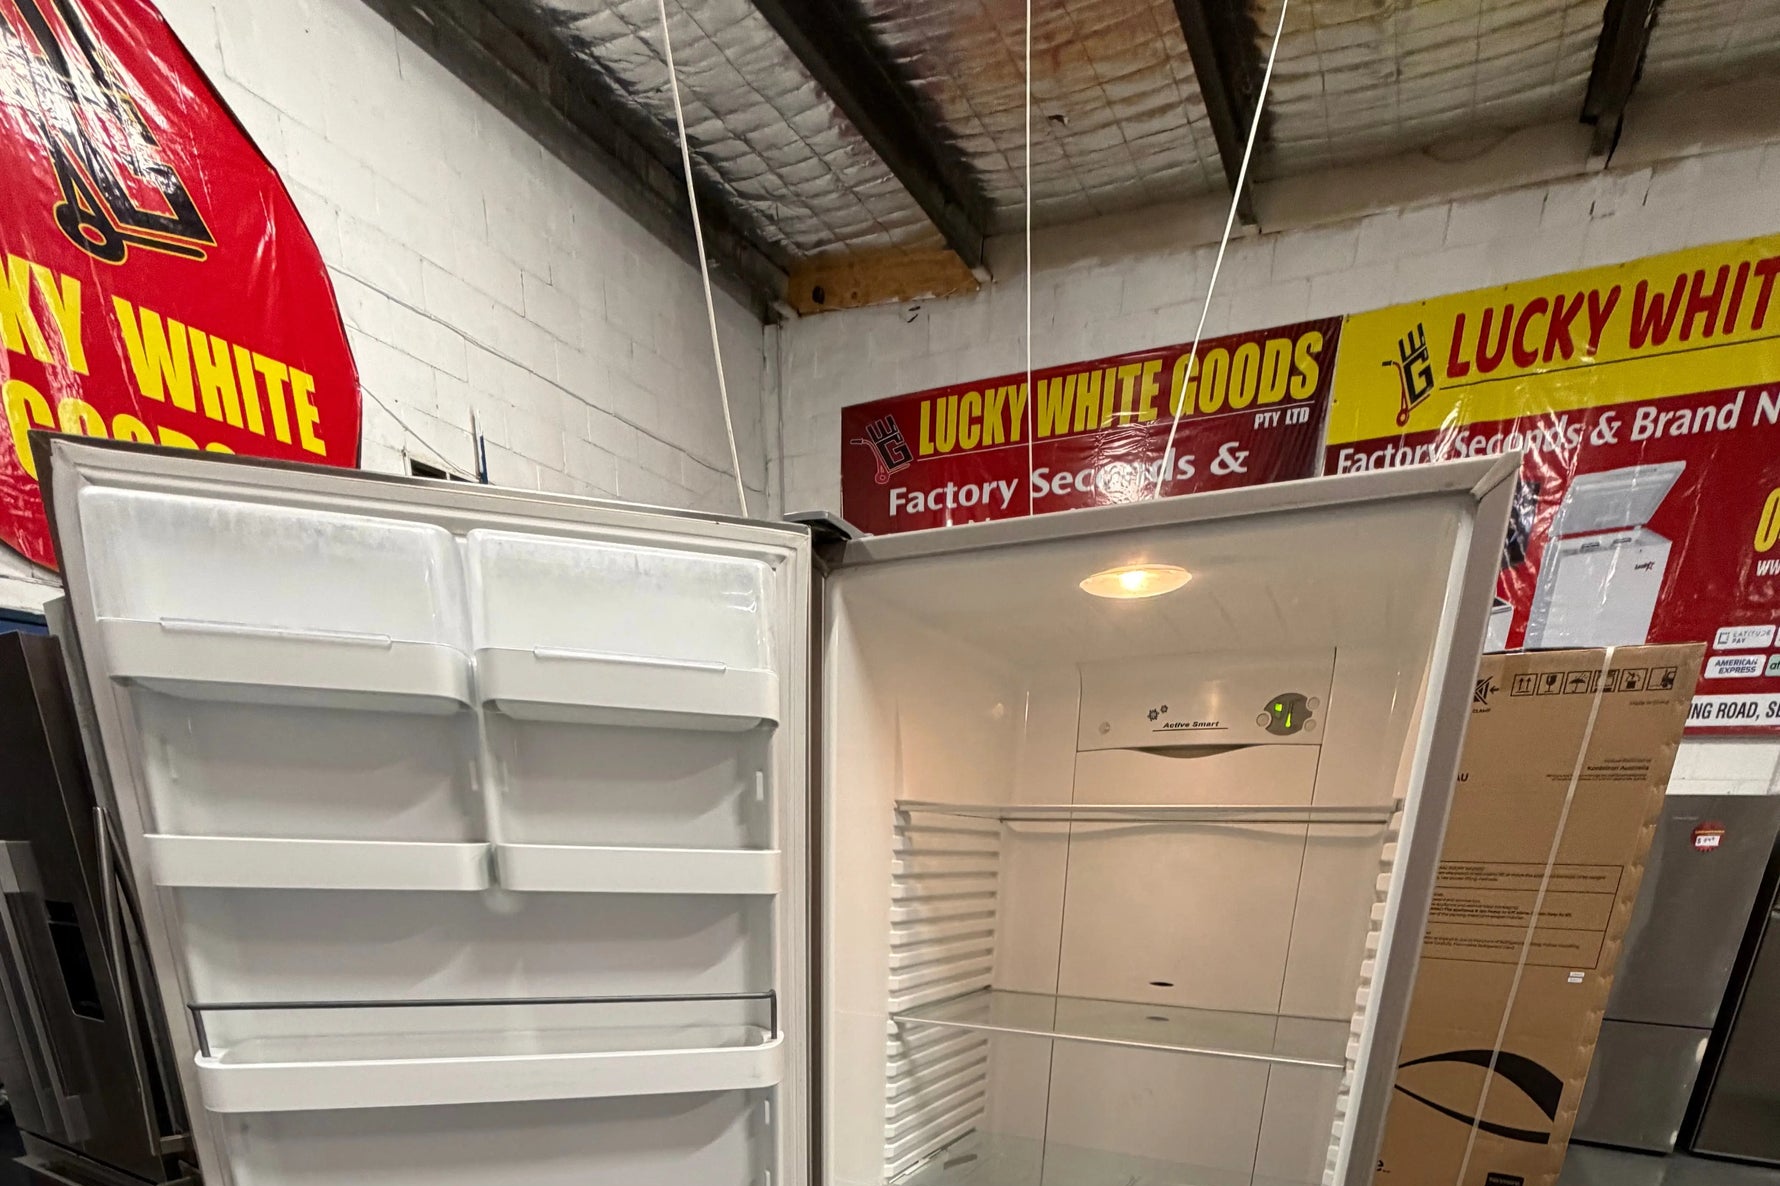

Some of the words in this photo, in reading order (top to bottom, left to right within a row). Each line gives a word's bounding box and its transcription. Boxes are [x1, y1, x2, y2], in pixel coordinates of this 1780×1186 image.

[1446, 285, 1622, 379] LUCKY
[111, 294, 327, 457] WHITE
[918, 382, 1029, 456] LUCKY
[1036, 359, 1163, 437] WHITE
[1170, 330, 1324, 417] GOODS
[1253, 411, 1281, 430] PTY
[1285, 407, 1309, 425] LTD
[1337, 442, 1437, 475] Factory
[1453, 414, 1582, 460] Seconds
[1590, 412, 1624, 446] &
[1631, 390, 1744, 442] Brand
[889, 478, 1018, 517] Factory
[1210, 441, 1250, 476] &
[1715, 658, 1758, 667] AMERICAN
[1718, 666, 1757, 674] EXPRESS
[1163, 721, 1190, 729] Active
[1192, 720, 1220, 728] Smart
[1715, 701, 1760, 722] ROAD,
